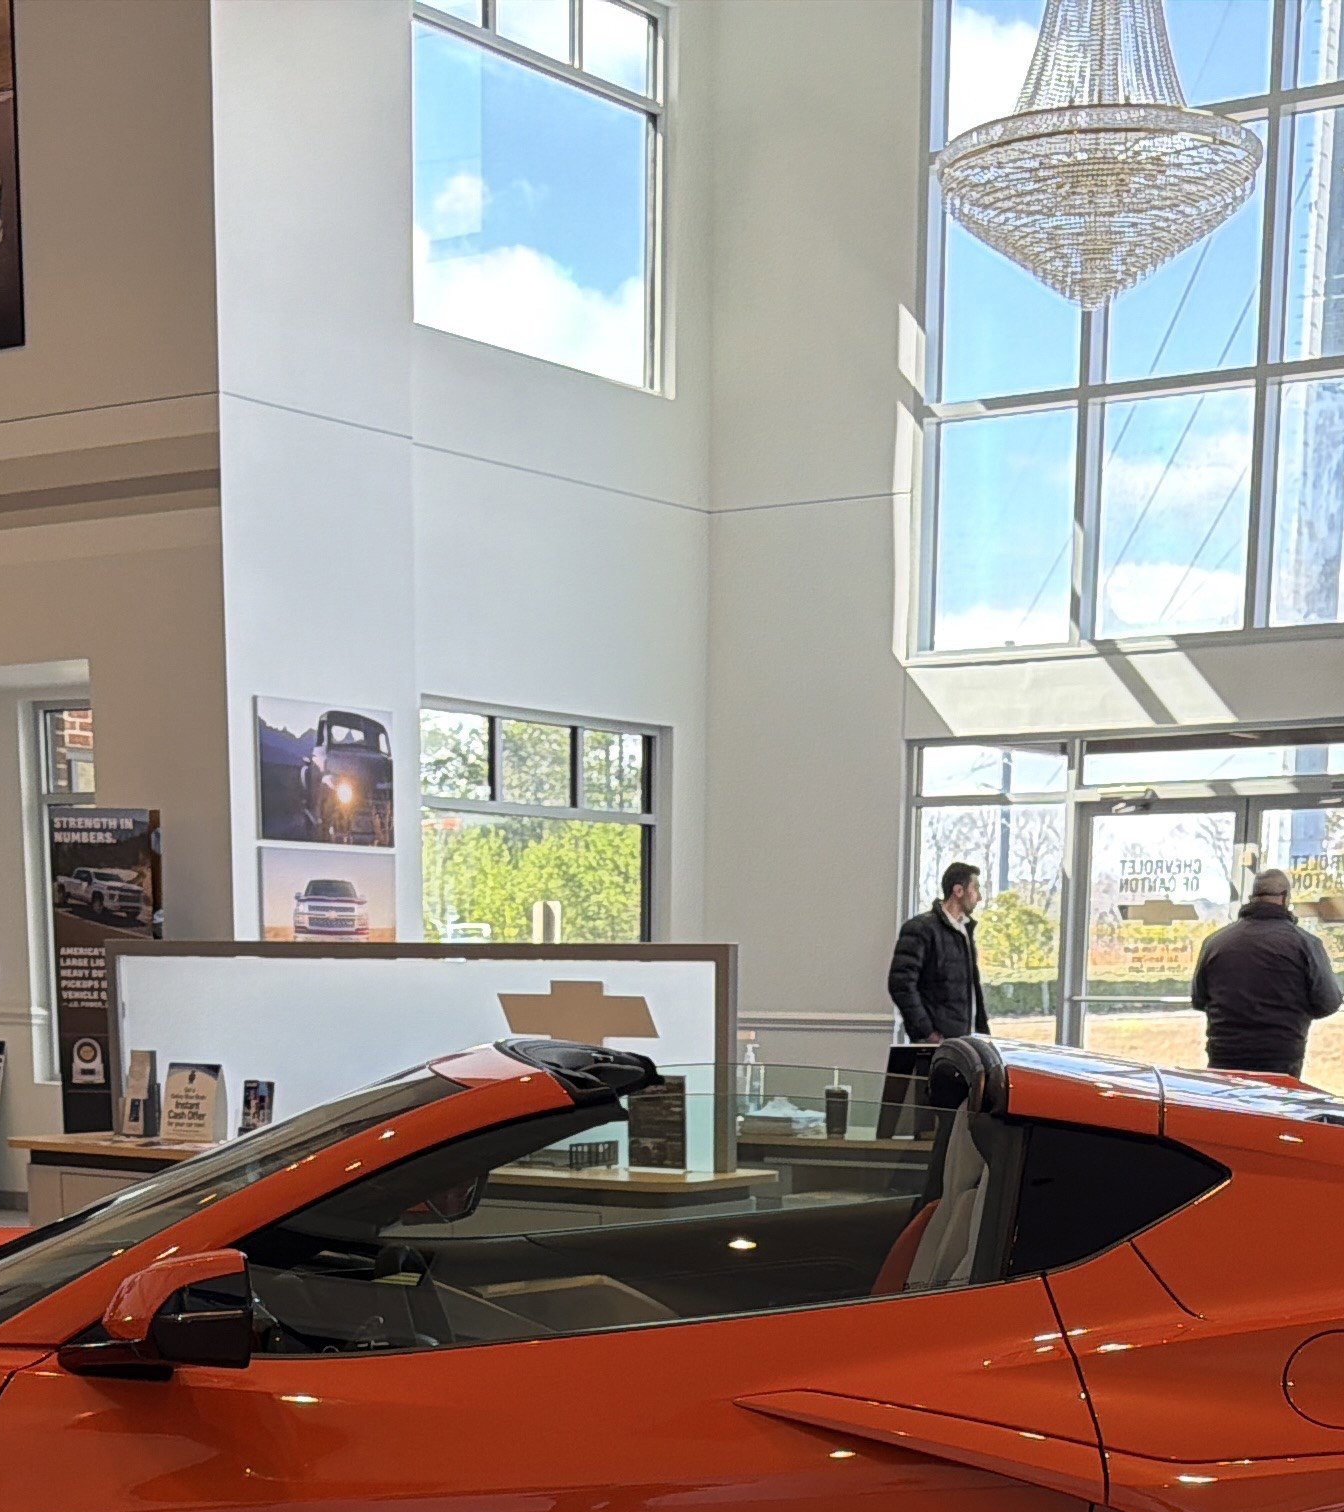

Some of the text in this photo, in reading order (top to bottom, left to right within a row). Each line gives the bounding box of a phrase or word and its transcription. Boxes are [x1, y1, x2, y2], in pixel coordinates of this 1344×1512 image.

[53, 817, 134, 830] STRENGTH IN
[53, 832, 117, 844] NUMBERS.
[174, 1101, 201, 1110] Instant
[167, 1110, 207, 1121] Cash Offer
